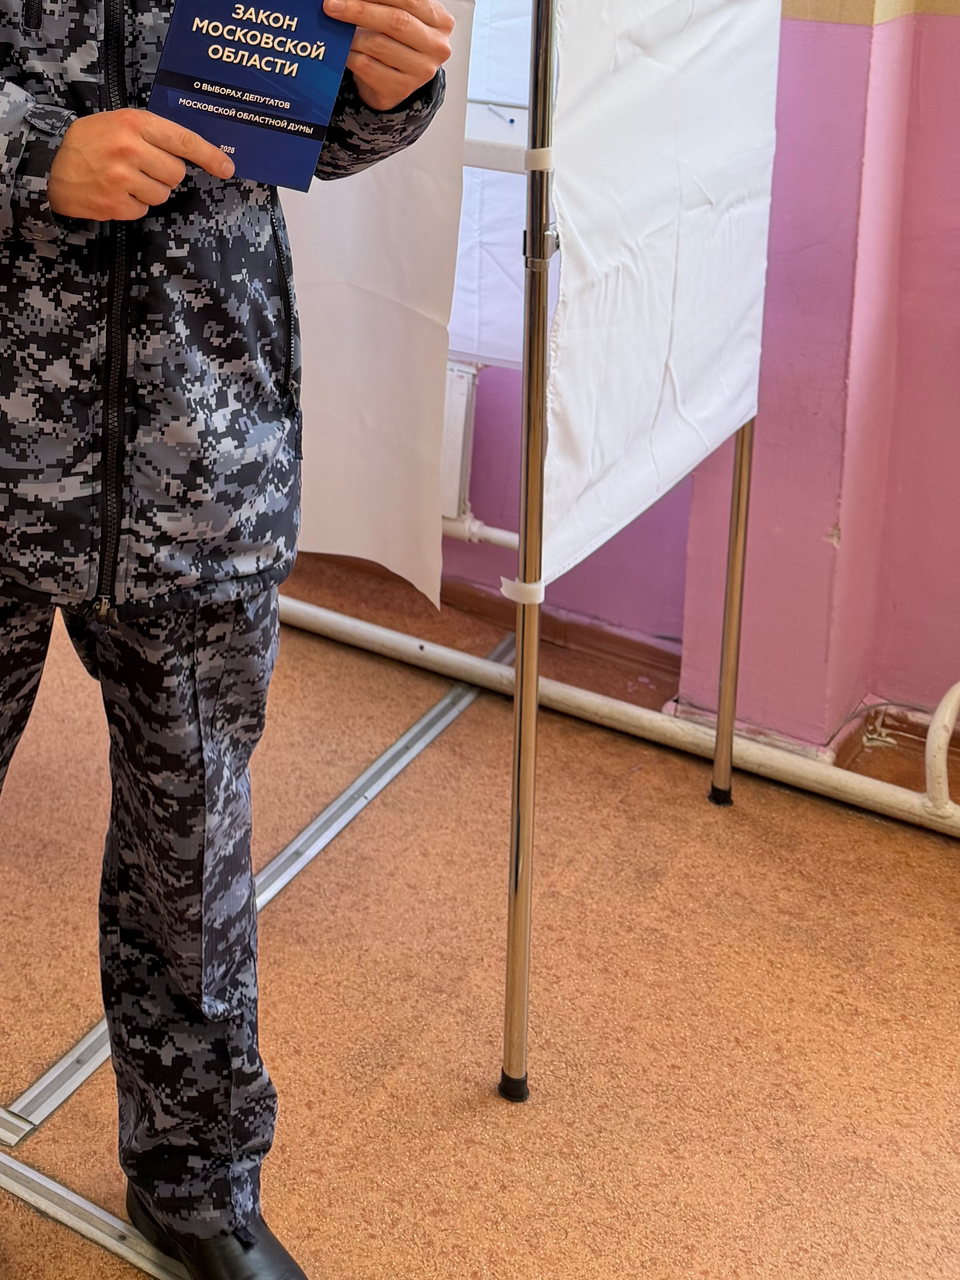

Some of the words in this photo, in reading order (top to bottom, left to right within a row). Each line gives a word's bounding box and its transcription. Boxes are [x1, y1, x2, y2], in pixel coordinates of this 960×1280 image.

[231, 3, 298, 32] ЗАКОН
[191, 17, 327, 61] МОСКОВСКОЙ
[208, 44, 299, 77] ОБЛАСТИ
[193, 81, 201, 89] О
[201, 83, 242, 99] ВЫБОРАХ
[242, 92, 291, 109] ДЕПУТАТОВ
[178, 97, 236, 117] МОСКОВСКОЙ
[236, 111, 287, 128] ОБЛАСТНОЙ
[288, 123, 314, 135] ДУМЫ
